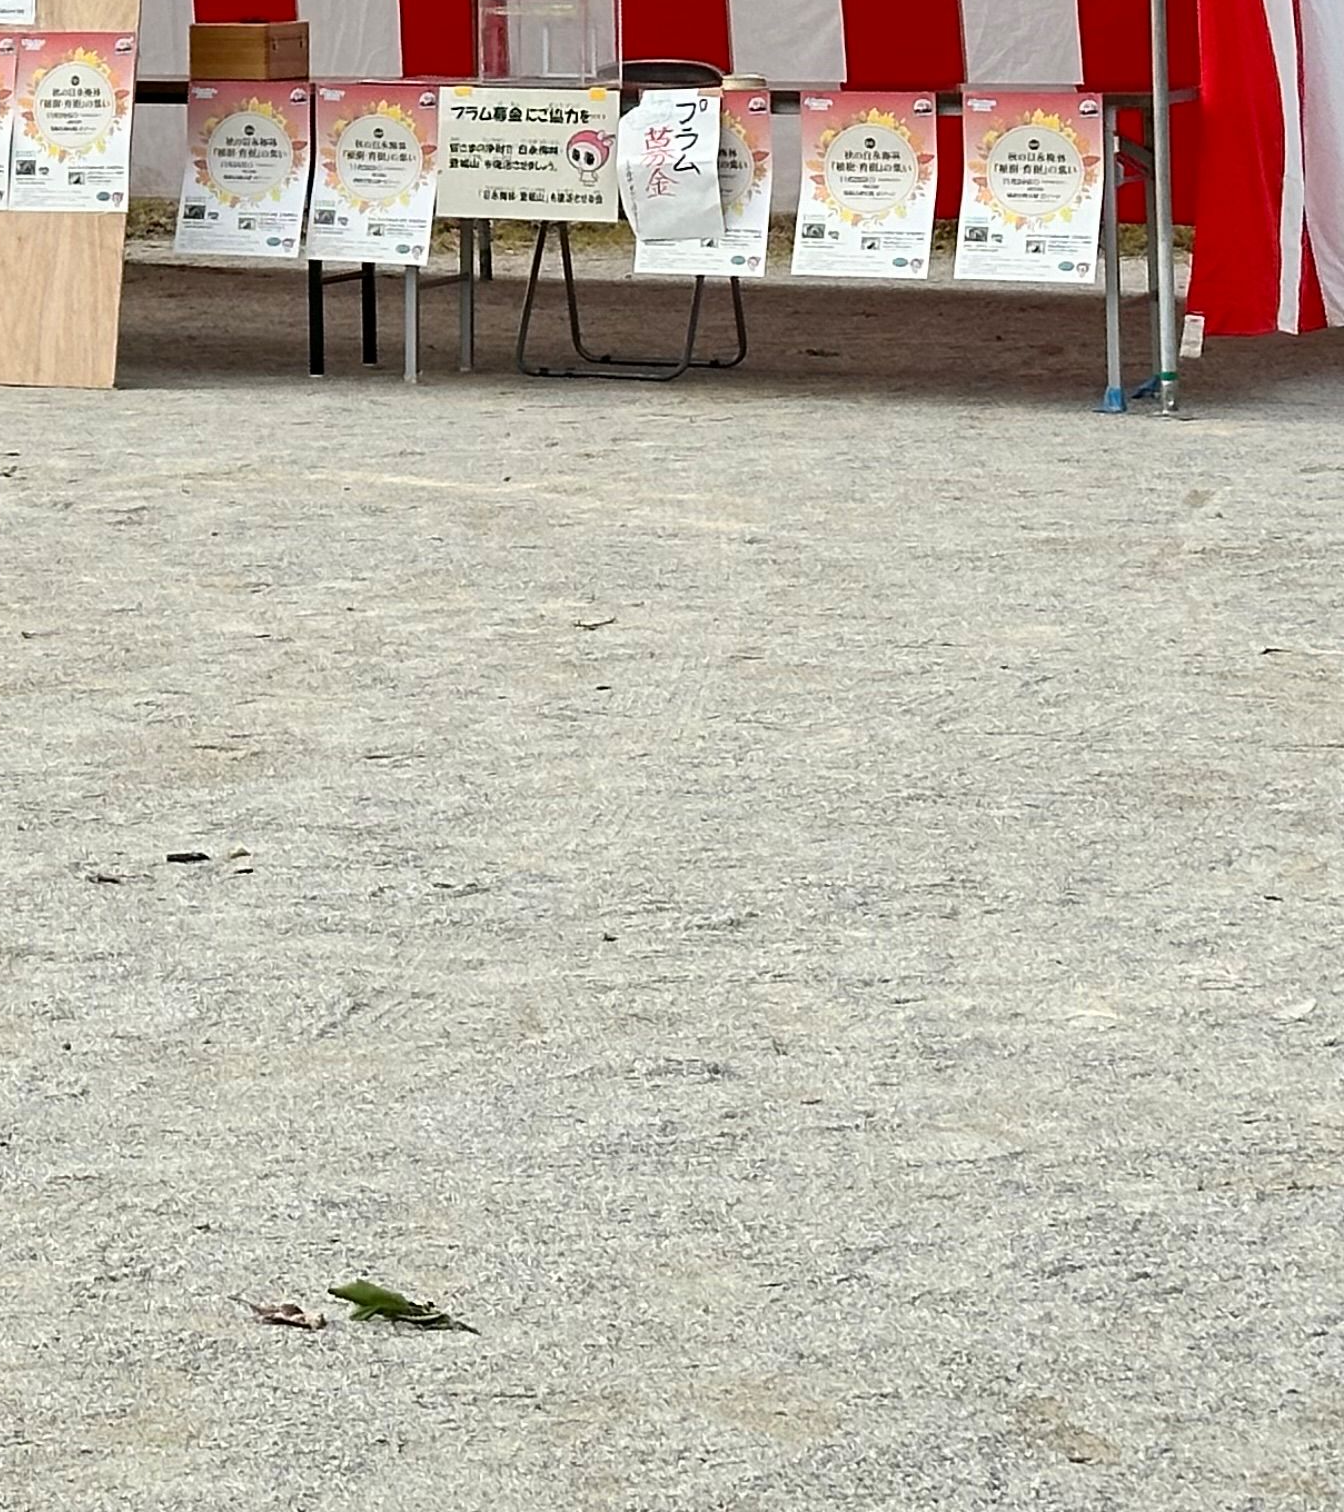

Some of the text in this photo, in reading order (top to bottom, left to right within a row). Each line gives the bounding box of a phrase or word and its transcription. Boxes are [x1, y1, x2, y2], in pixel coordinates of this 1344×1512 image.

[640, 124, 680, 199] 募金
[673, 99, 708, 175] プラム
